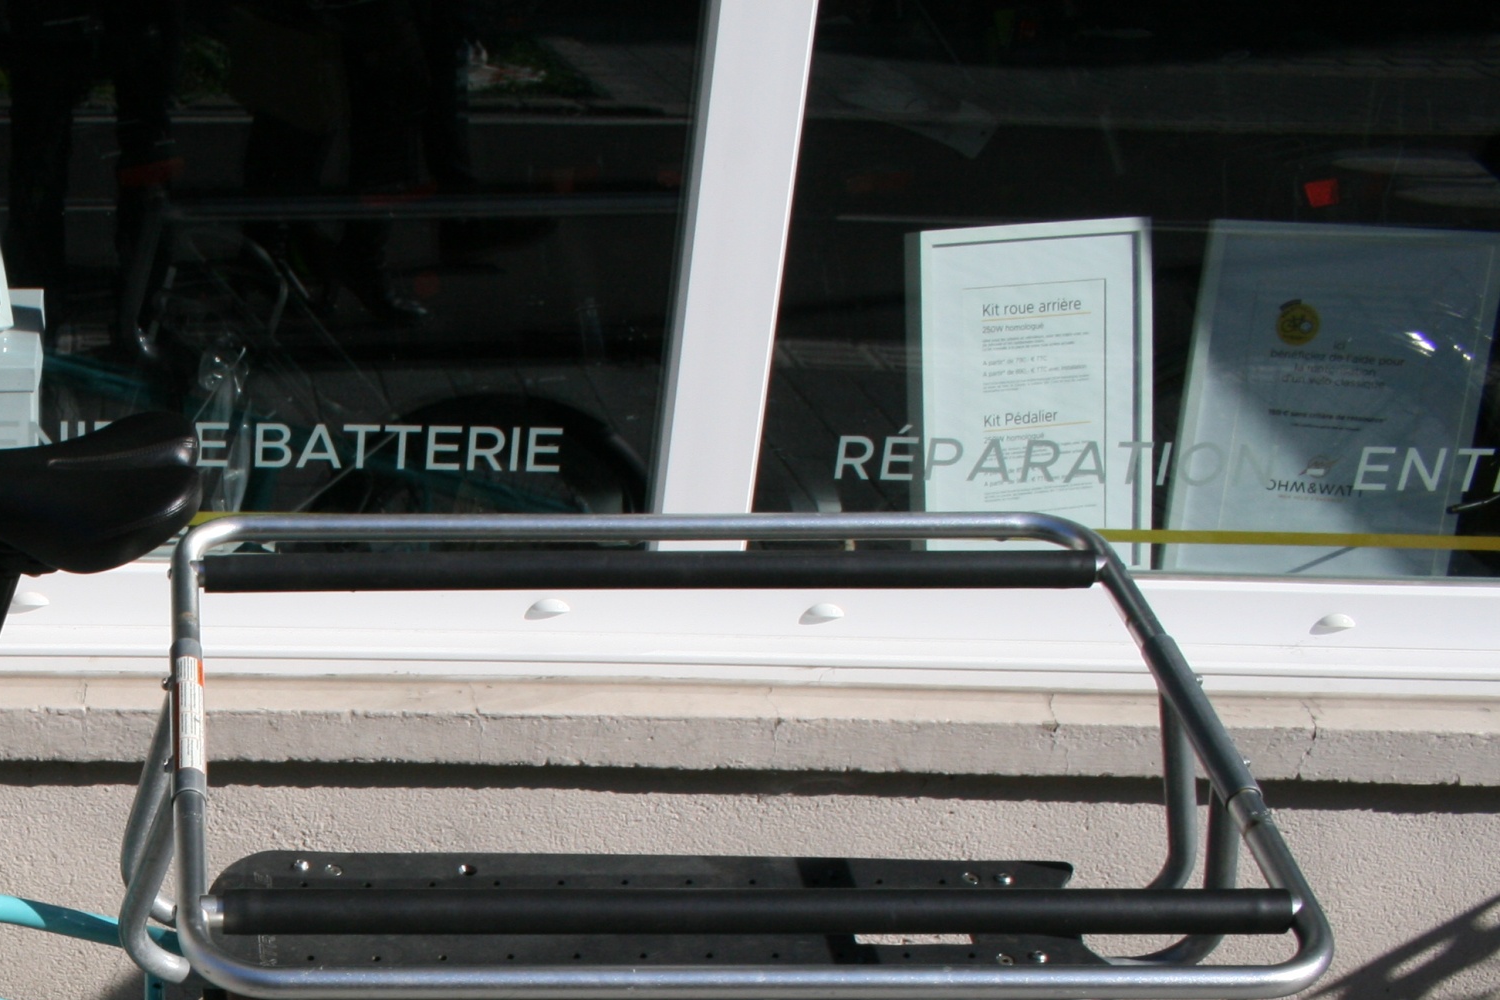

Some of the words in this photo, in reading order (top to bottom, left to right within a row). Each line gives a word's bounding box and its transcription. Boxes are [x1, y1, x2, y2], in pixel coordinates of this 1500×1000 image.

[982, 303, 1000, 317] Kit
[1003, 303, 1034, 316] roue
[1038, 298, 1082, 313] arrière
[1004, 322, 1044, 334] homologué
[983, 415, 1000, 428] Kit
[1005, 409, 1058, 426] Pédalier
[254, 422, 564, 473] BATTERIE
[834, 424, 1278, 488] RÉPARATION
[1354, 446, 1500, 493] ENT
